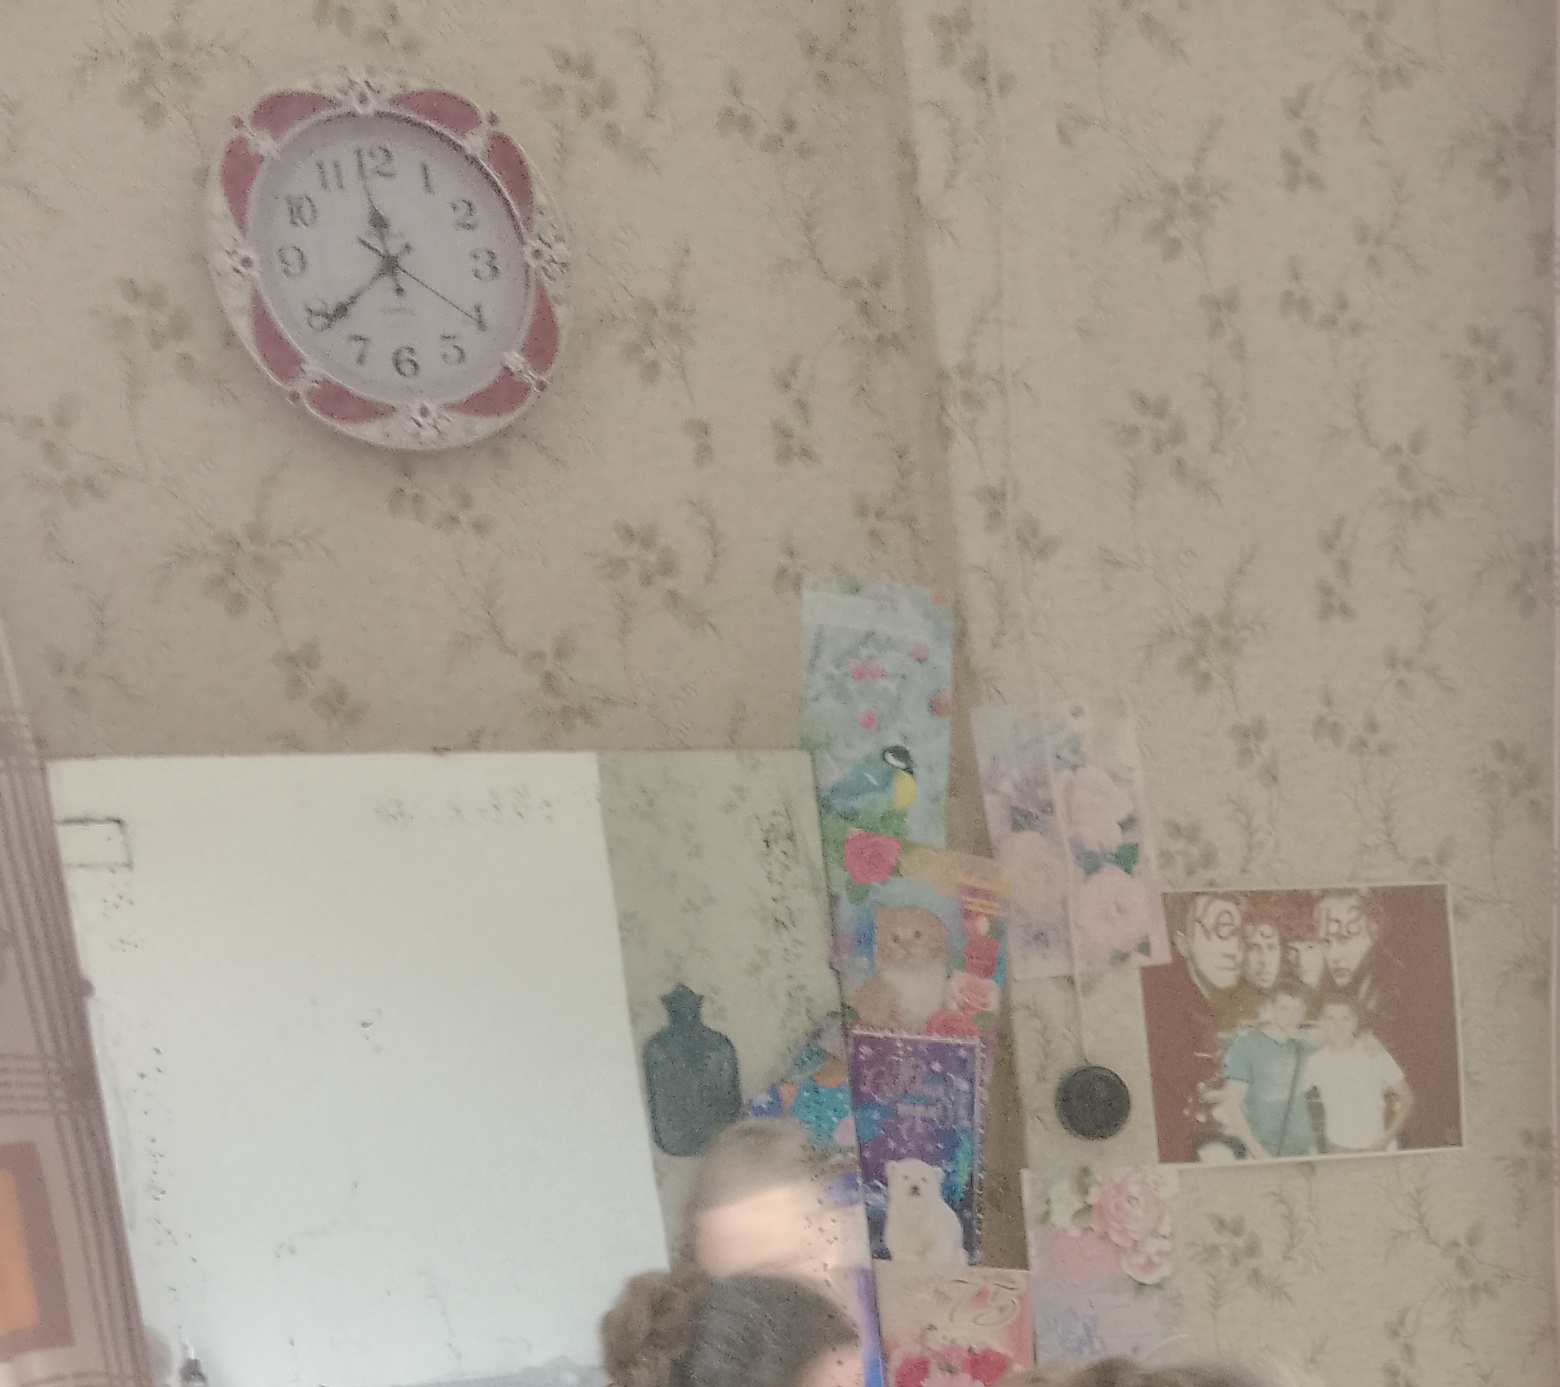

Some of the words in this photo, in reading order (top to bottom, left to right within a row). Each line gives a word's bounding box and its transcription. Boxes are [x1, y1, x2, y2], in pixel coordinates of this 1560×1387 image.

[316, 160, 344, 191] 11
[419, 161, 434, 195] 1
[287, 194, 317, 229] 10
[450, 198, 477, 231] 2
[277, 244, 307, 279] 9
[470, 246, 500, 282] 3
[346, 333, 370, 367] 7
[391, 345, 420, 379] 6
[440, 333, 466, 366] 5
